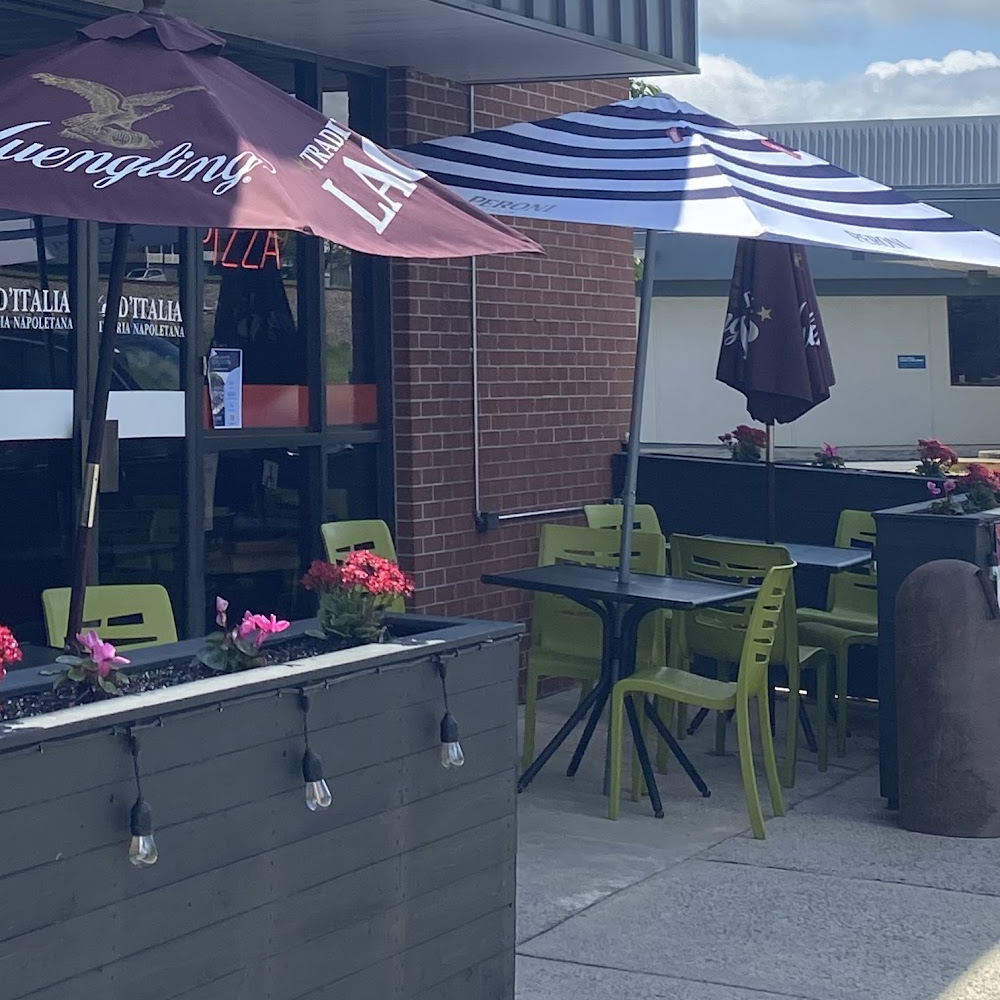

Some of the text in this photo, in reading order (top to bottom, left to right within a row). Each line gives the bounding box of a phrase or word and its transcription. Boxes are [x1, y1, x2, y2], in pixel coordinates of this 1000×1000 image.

[468, 196, 557, 213] PERONI
[118, 295, 183, 323] D'ITALIA
[13, 315, 74, 330] NAPOLETANA
[132, 322, 185, 338] NAPOLETANA
